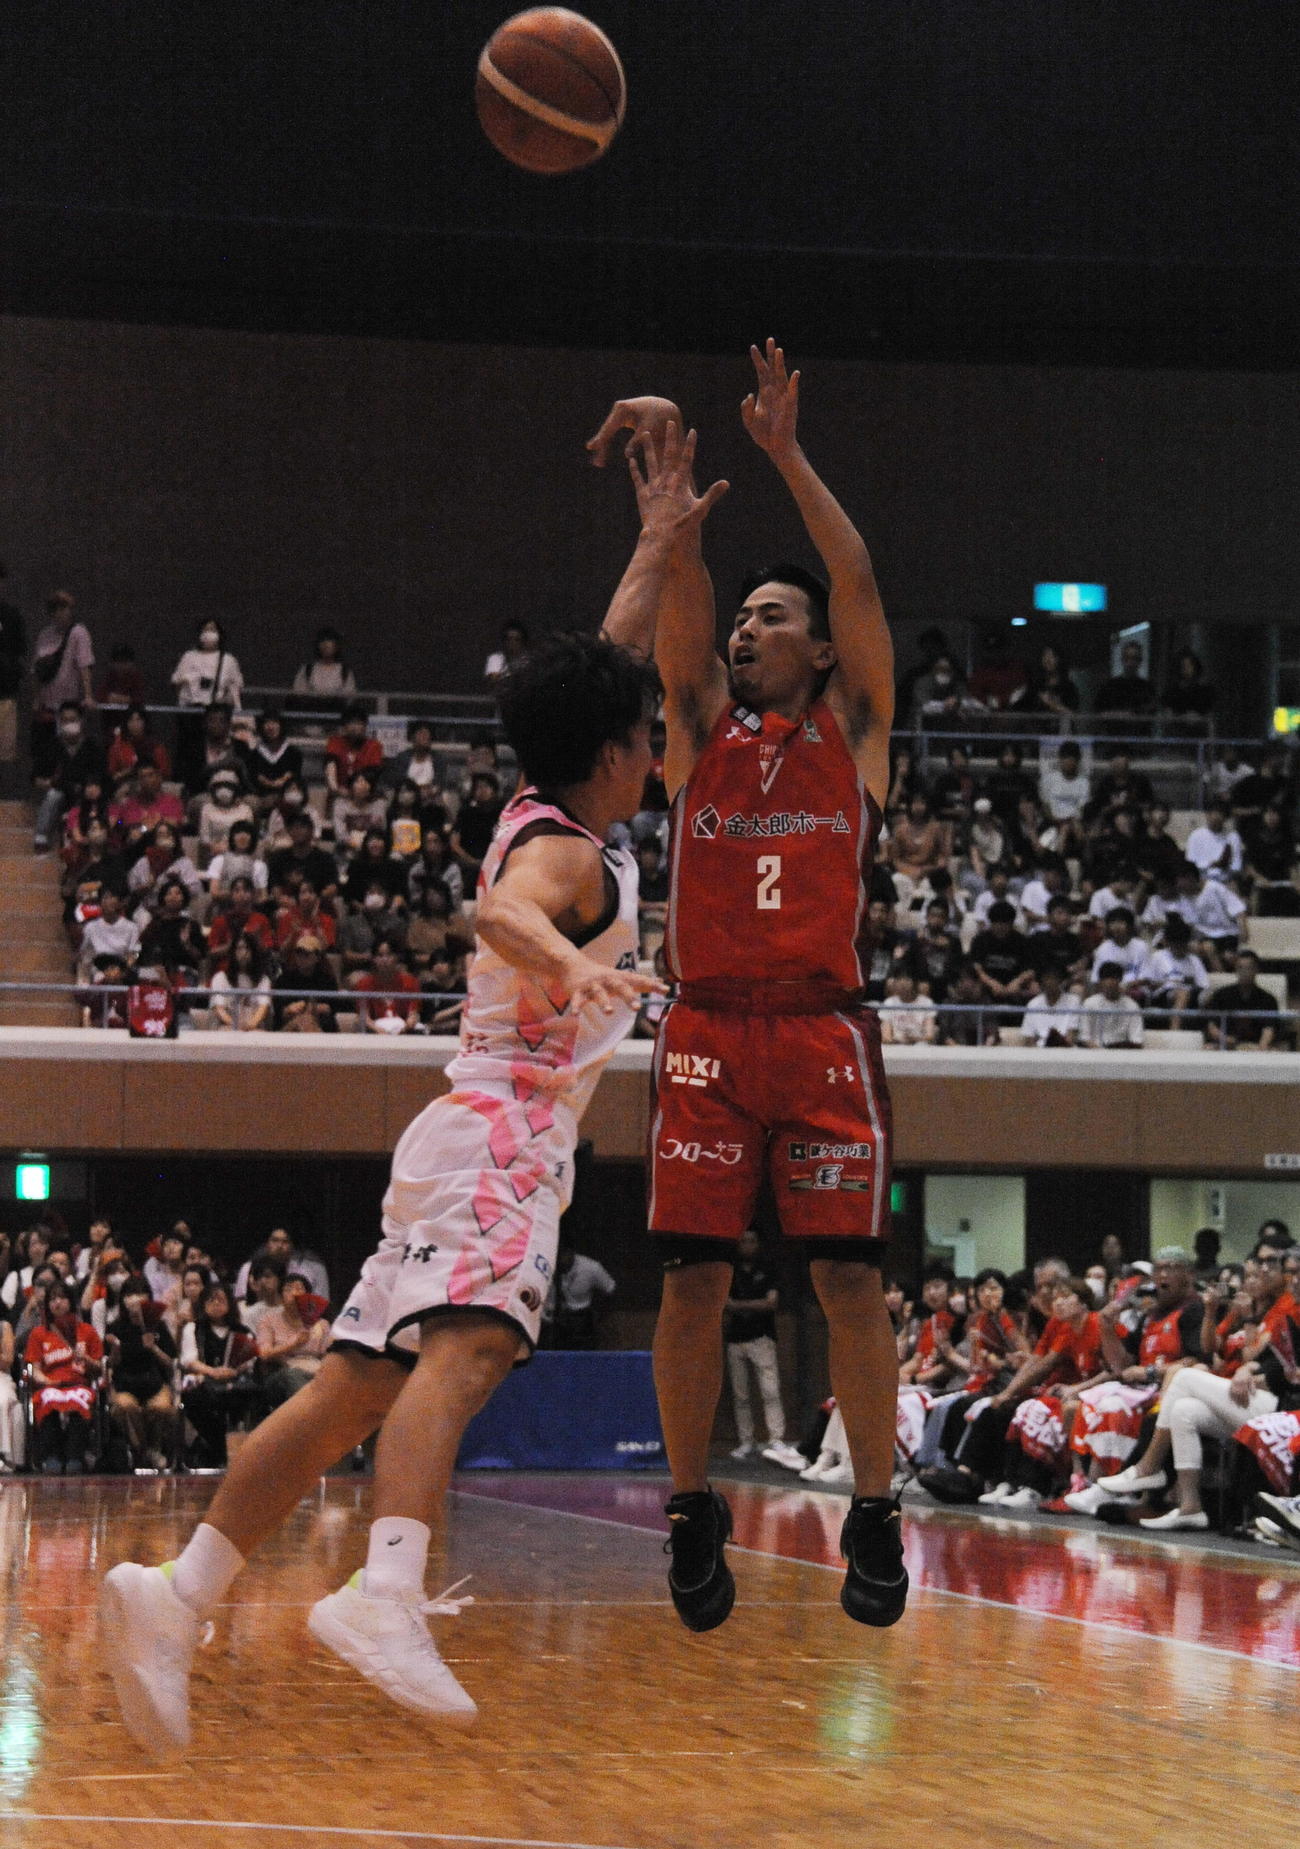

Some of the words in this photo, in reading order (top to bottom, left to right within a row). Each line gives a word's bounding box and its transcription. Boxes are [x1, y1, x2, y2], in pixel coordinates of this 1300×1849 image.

[724, 810, 850, 837] 金太郎ホーム
[757, 855, 781, 909] 2
[665, 1051, 721, 1079] MIXI
